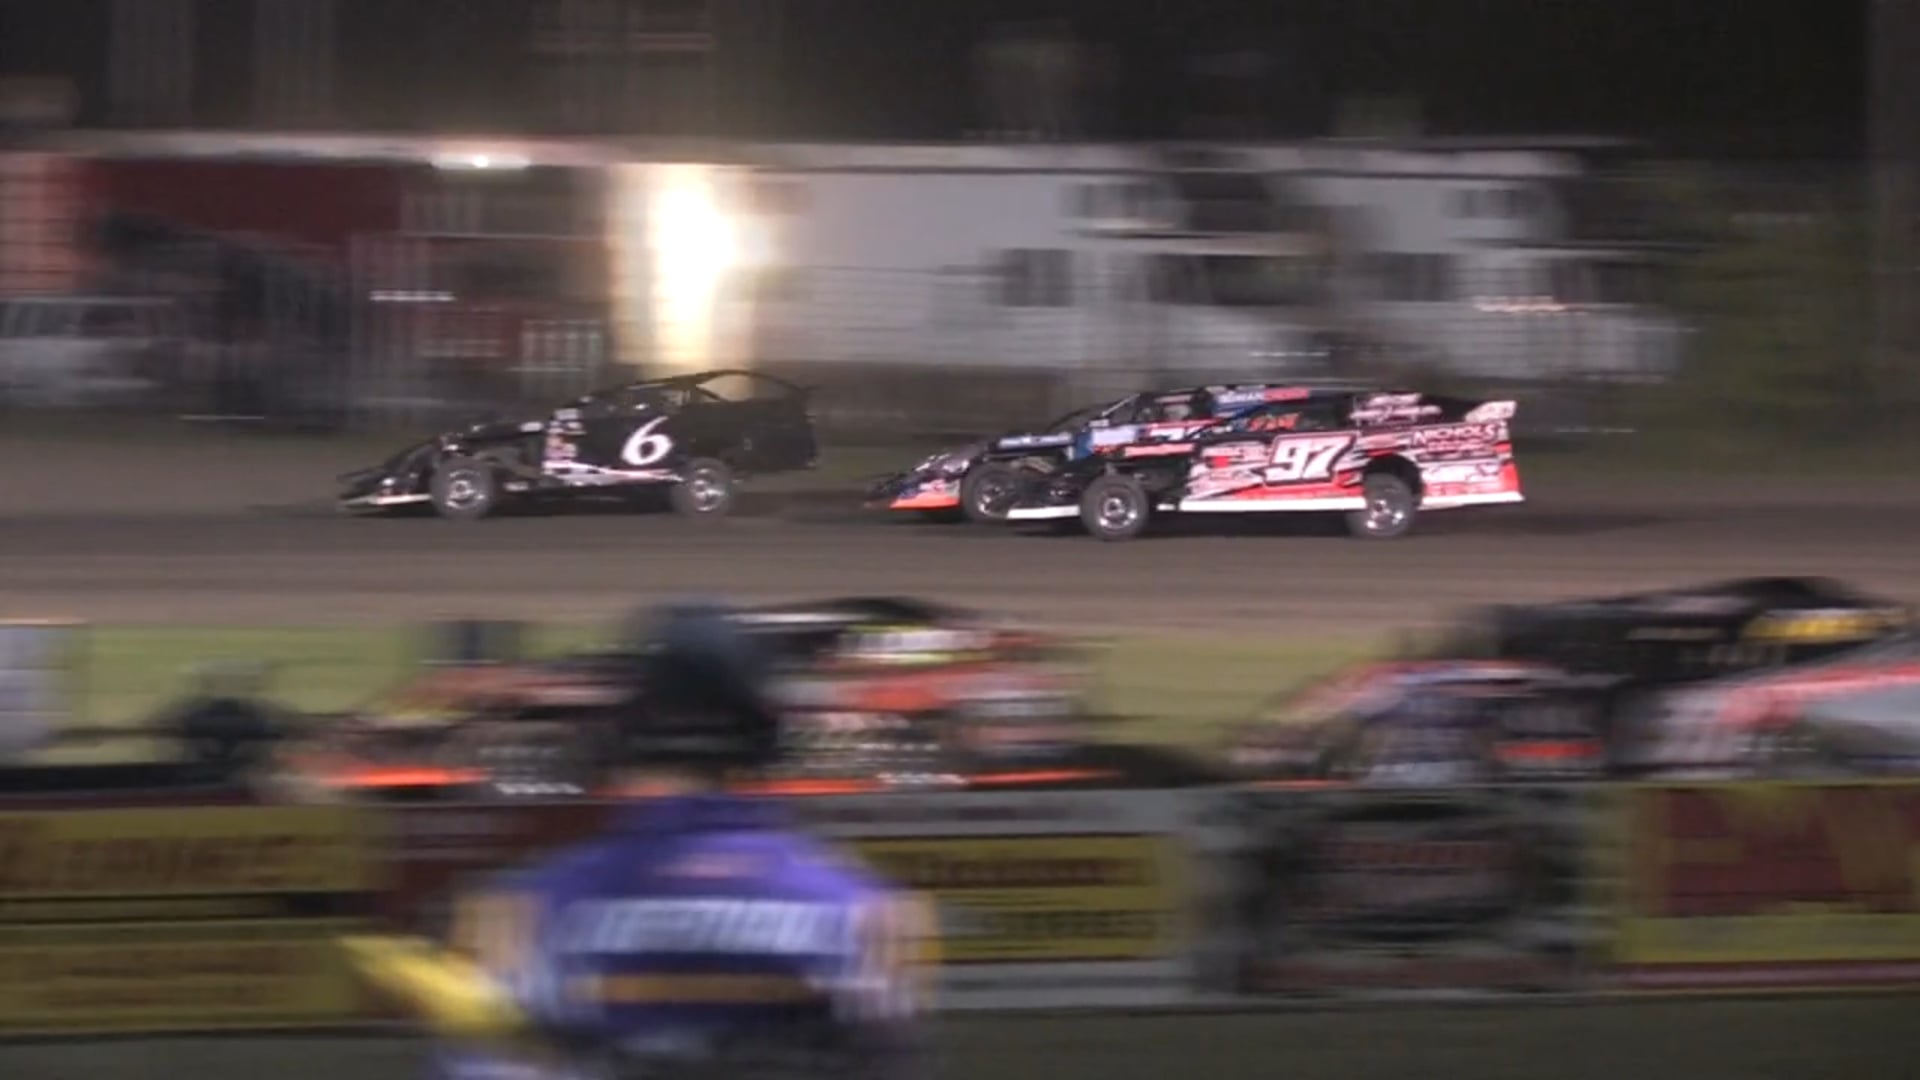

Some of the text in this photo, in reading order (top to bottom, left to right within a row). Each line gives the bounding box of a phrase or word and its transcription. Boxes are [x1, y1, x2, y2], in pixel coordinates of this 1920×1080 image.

[620, 415, 673, 467] 6
[1267, 434, 1353, 481] 97
[1414, 424, 1497, 445] NICHOLS
